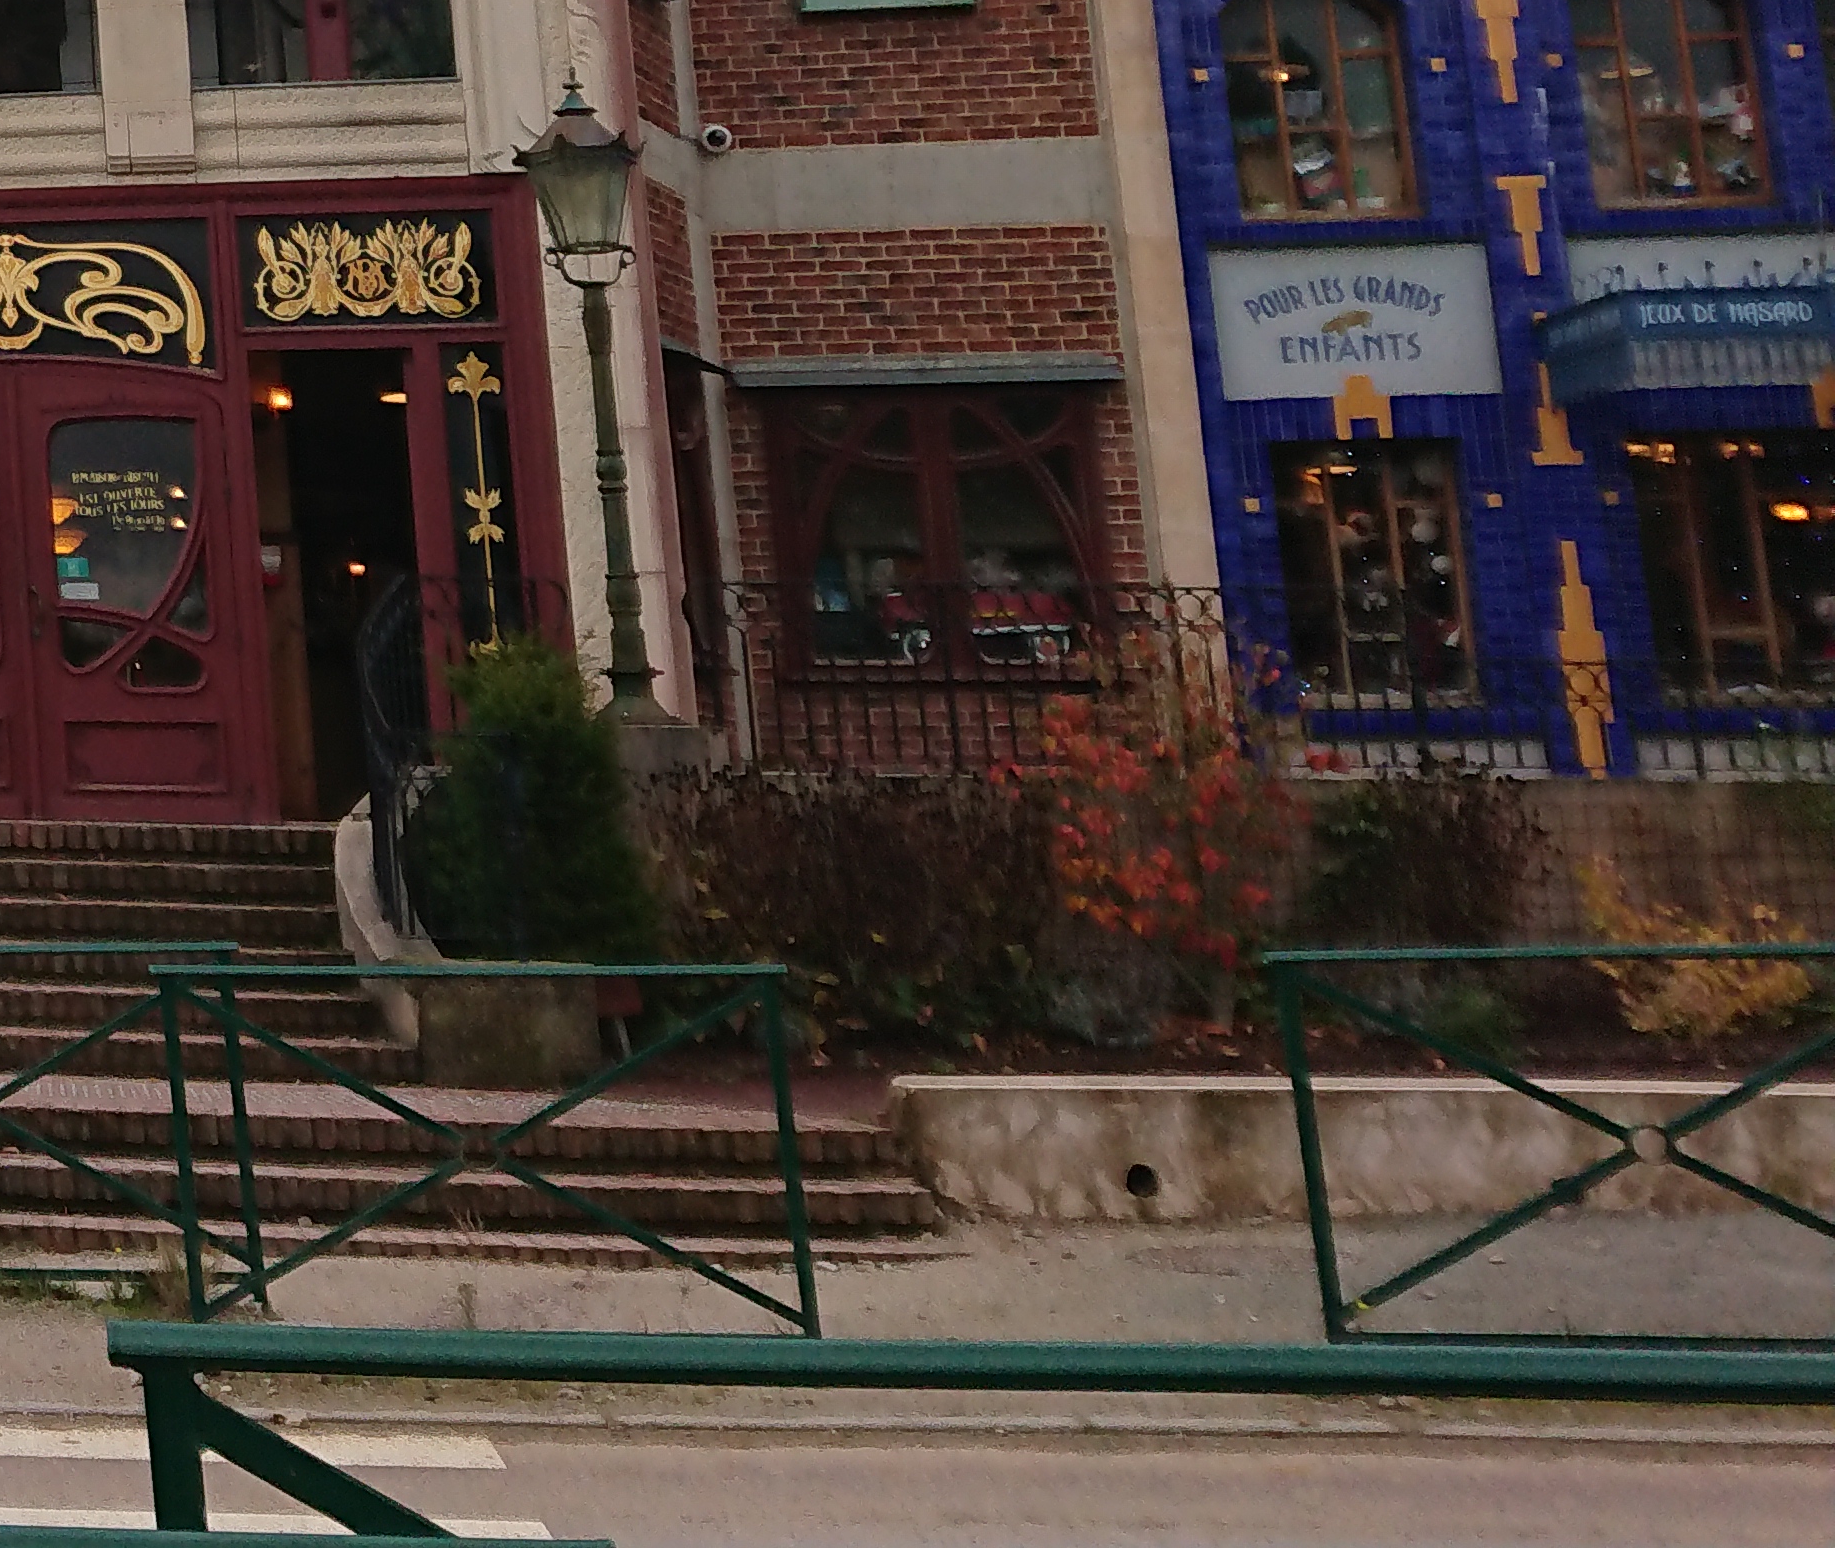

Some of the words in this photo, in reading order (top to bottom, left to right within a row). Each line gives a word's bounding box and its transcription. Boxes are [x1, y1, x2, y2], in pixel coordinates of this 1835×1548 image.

[1243, 284, 1308, 325] POUR
[1307, 277, 1346, 307] LES
[1352, 274, 1447, 317] GRANDS
[1692, 302, 1718, 323] DE
[1279, 331, 1423, 364] ENFANTS
